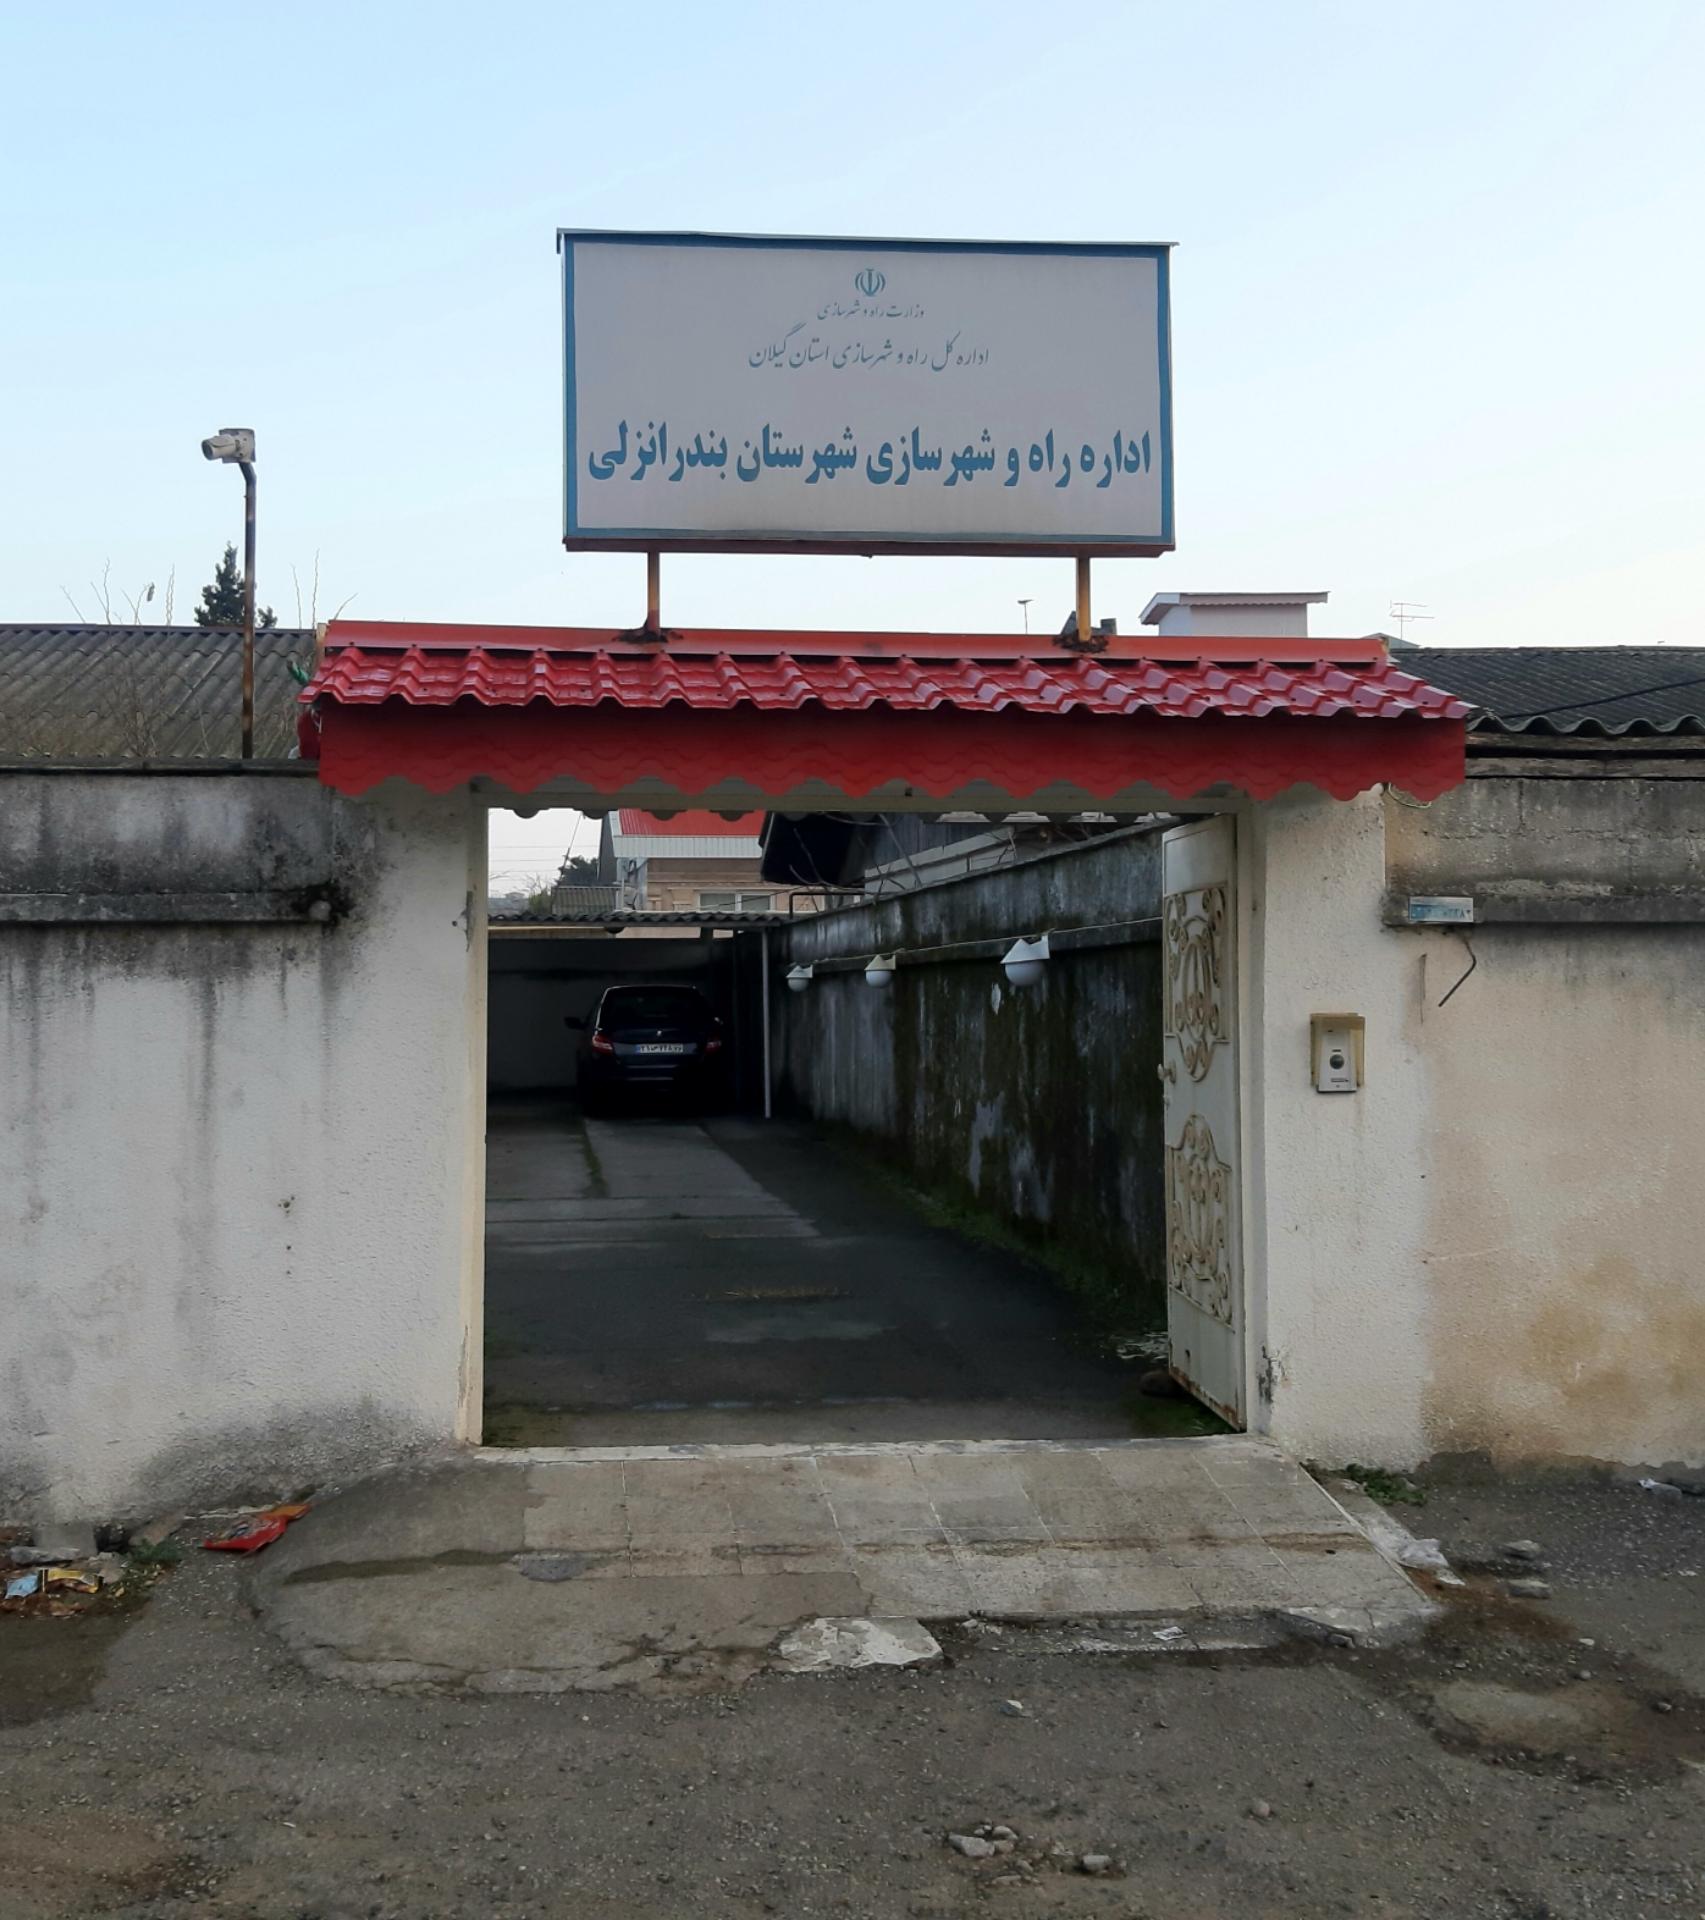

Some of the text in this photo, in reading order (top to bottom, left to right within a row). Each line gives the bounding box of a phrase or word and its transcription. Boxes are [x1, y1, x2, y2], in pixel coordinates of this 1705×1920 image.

[817, 299, 861, 320] شهرسازی
[869, 305, 885, 319] راه
[886, 303, 925, 319] وزارت
[748, 322, 989, 372] اداره کل راه و شهرسازی استان گیلان
[588, 419, 1151, 489] اداره راه و شهرسازی شهرستان بندر انزلی
